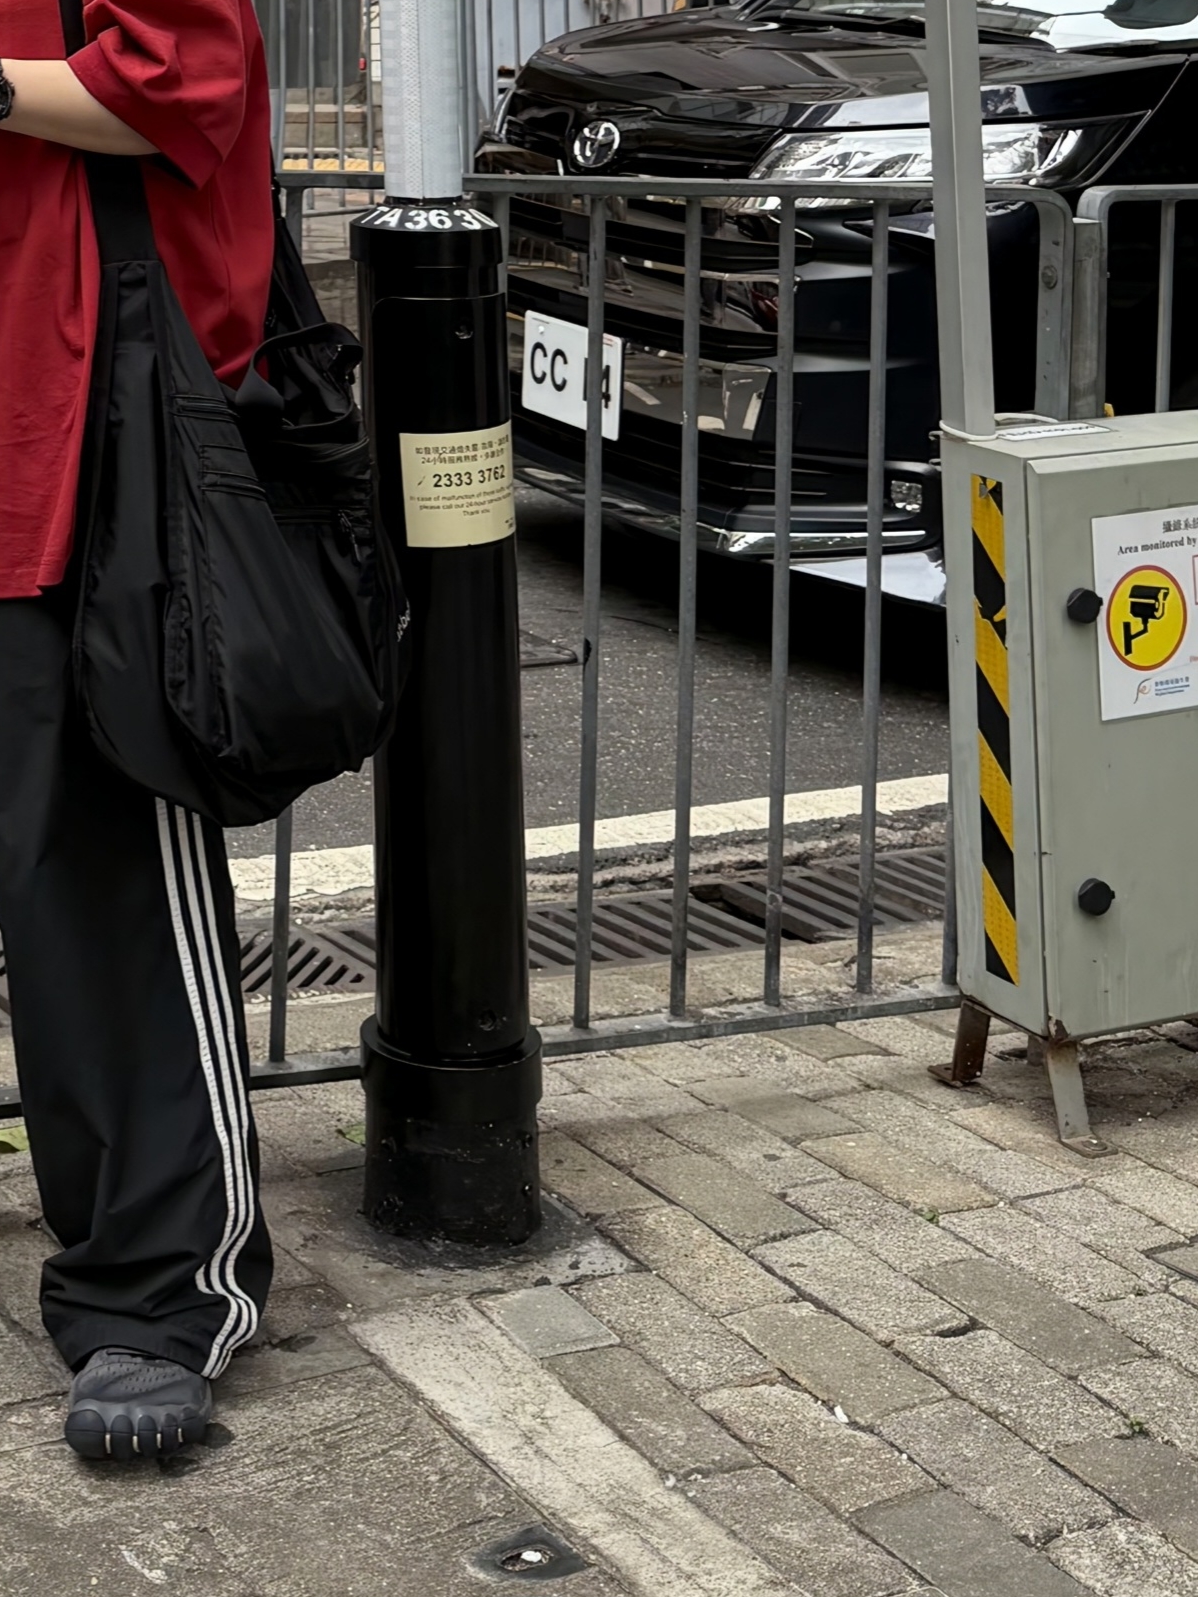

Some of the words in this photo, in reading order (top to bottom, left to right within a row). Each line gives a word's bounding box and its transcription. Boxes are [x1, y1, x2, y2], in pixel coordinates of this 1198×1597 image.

[530, 341, 568, 392] CC
[432, 471, 473, 488] 2333
[477, 464, 506, 484] 3762
[1117, 545, 1139, 556] Area
[1141, 536, 1185, 553] monitored
[1186, 535, 1197, 547] by
